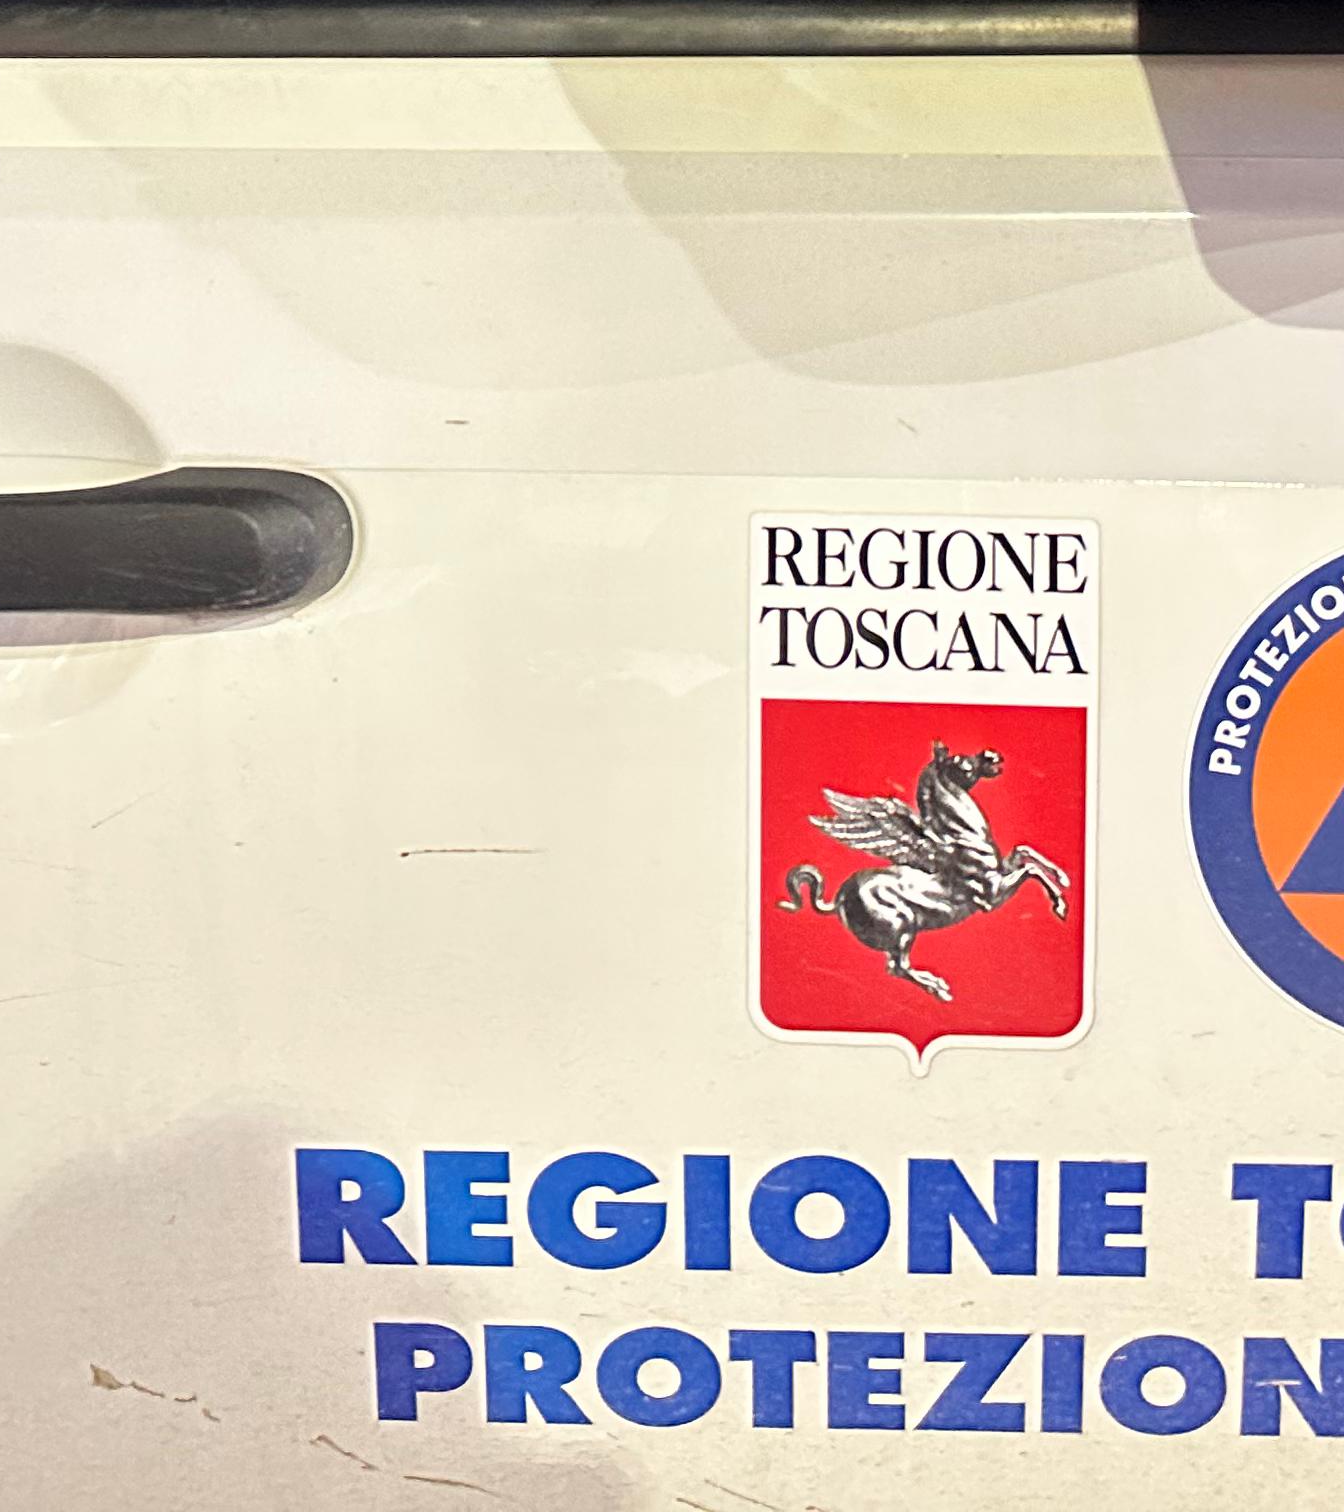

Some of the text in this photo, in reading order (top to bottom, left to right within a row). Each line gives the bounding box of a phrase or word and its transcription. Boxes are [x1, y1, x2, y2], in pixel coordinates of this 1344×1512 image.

[760, 526, 1089, 594] REGIONE
[759, 606, 1089, 675] TOSCANA
[295, 1148, 1148, 1277] REGIONE
